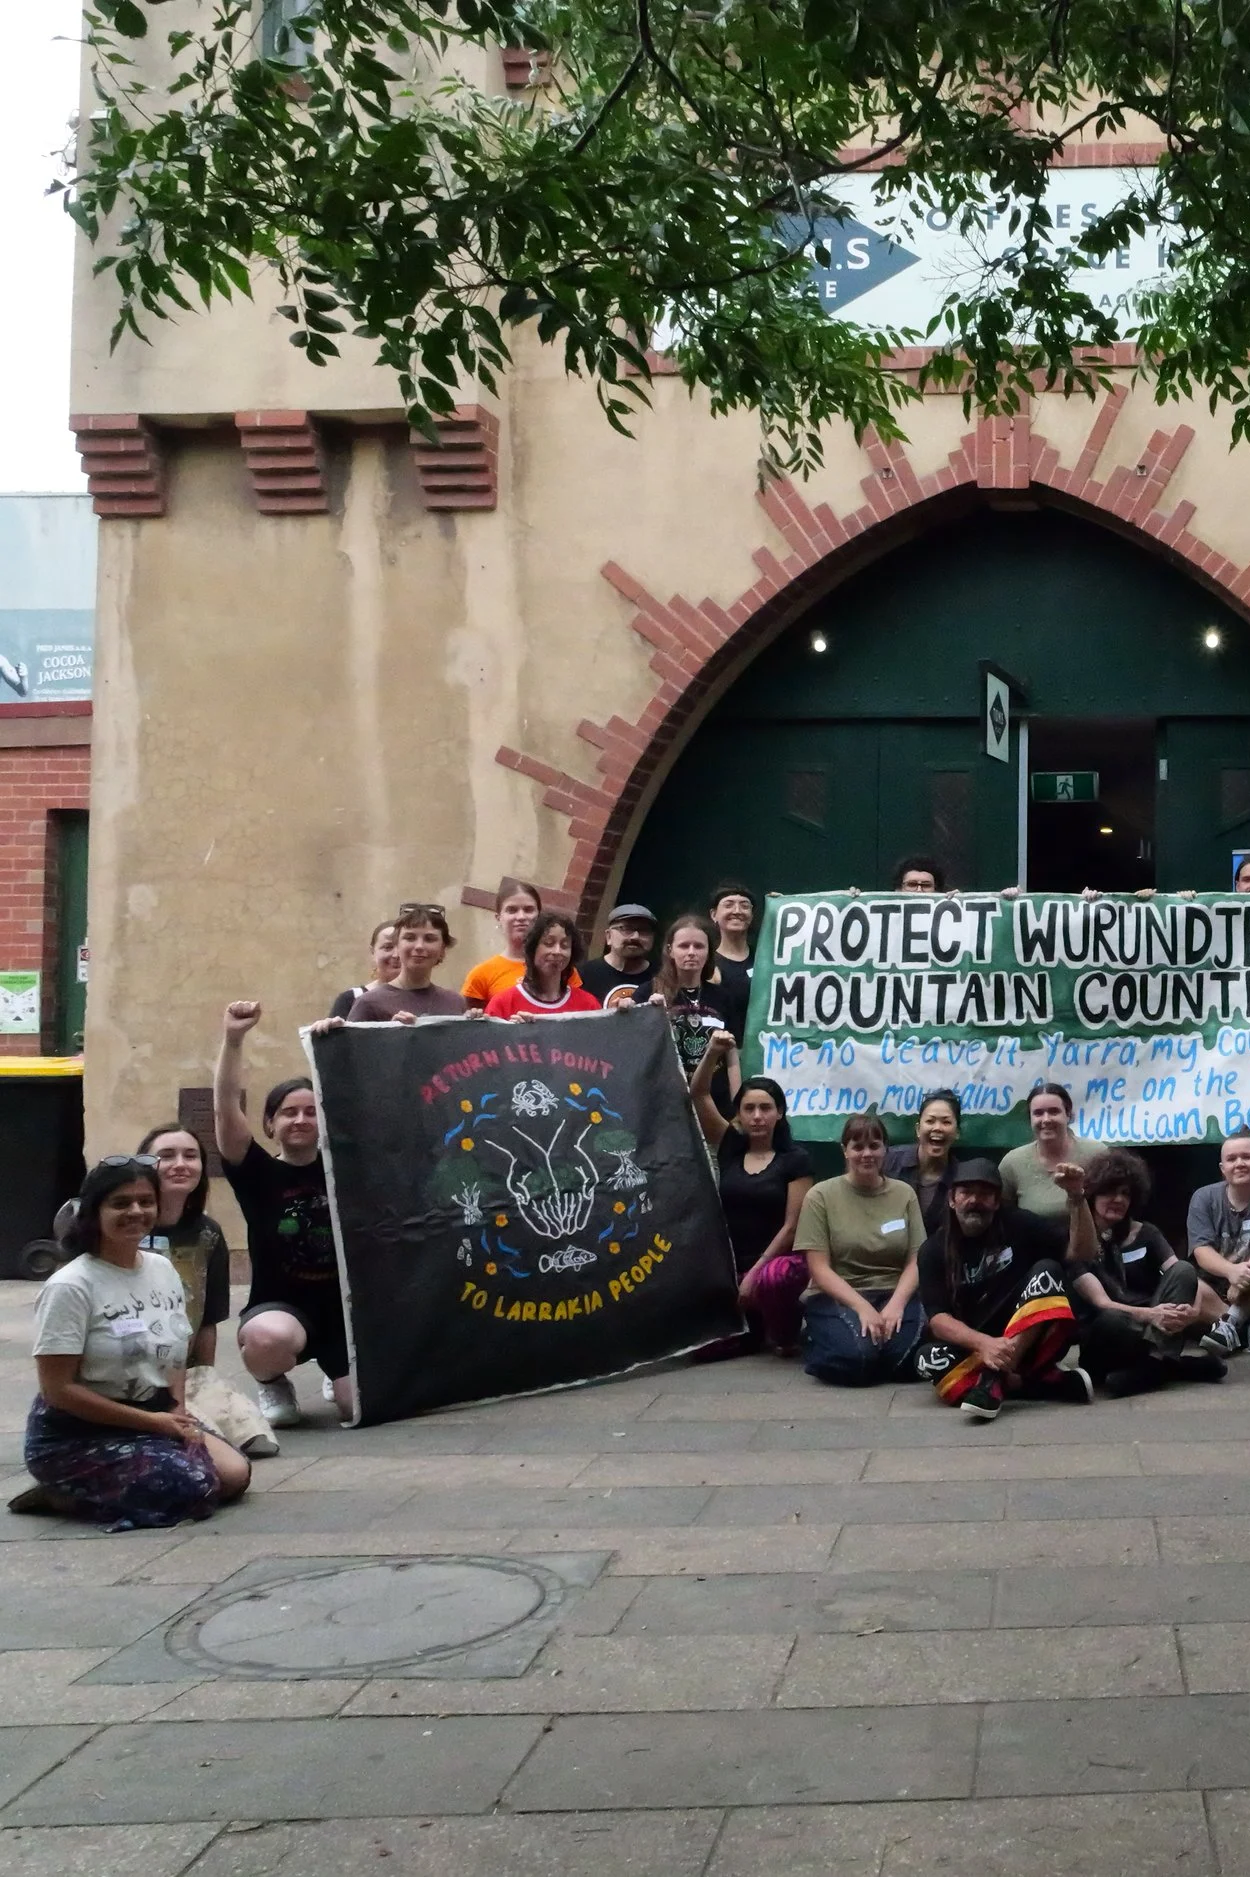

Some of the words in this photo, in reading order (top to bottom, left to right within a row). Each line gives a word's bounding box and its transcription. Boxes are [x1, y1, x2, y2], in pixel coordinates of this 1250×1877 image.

[37, 665, 91, 685] JACKSON
[43, 655, 84, 668] COCOA
[776, 901, 998, 965] PROTECT
[771, 973, 1047, 1027] MOUNTAIN
[420, 1049, 500, 1104] RETURN
[505, 1043, 543, 1064] LEE
[550, 1048, 614, 1080] POINT
[816, 1039, 855, 1067] no
[1151, 1036, 1198, 1073] my
[836, 1087, 868, 1111] no
[1086, 1076, 1126, 1104] me
[1142, 1076, 1176, 1102] on
[1194, 1066, 1238, 1098] the
[460, 1281, 488, 1310] TO
[493, 1290, 603, 1322] LARRAKIA
[608, 1232, 672, 1301] PEOPLE
